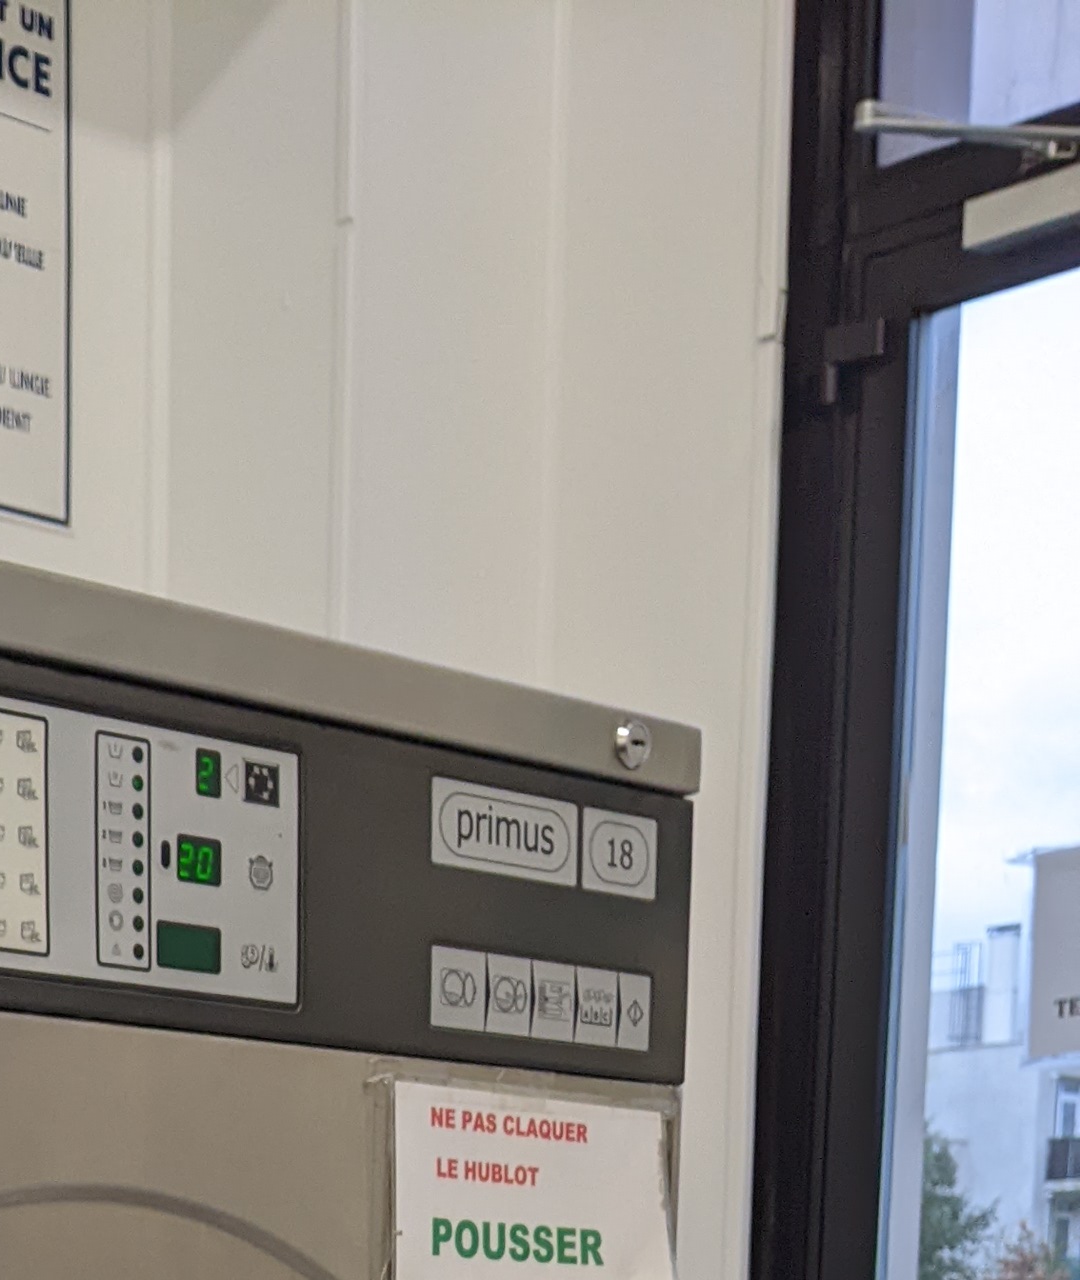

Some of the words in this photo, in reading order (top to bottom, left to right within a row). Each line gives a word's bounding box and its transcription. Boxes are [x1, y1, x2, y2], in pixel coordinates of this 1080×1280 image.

[21, 5, 54, 41] UN
[9, 366, 53, 399] LINGE
[198, 756, 213, 791] 2
[457, 805, 555, 855] primus
[179, 842, 213, 880] 20
[607, 838, 634, 870] 18
[430, 1107, 456, 1129] NE
[461, 1110, 497, 1134] PAS
[502, 1115, 589, 1143] CLAQUER
[436, 1157, 459, 1179] LE
[465, 1161, 540, 1186] HUBLOT
[431, 1217, 604, 1267] POUSSER
